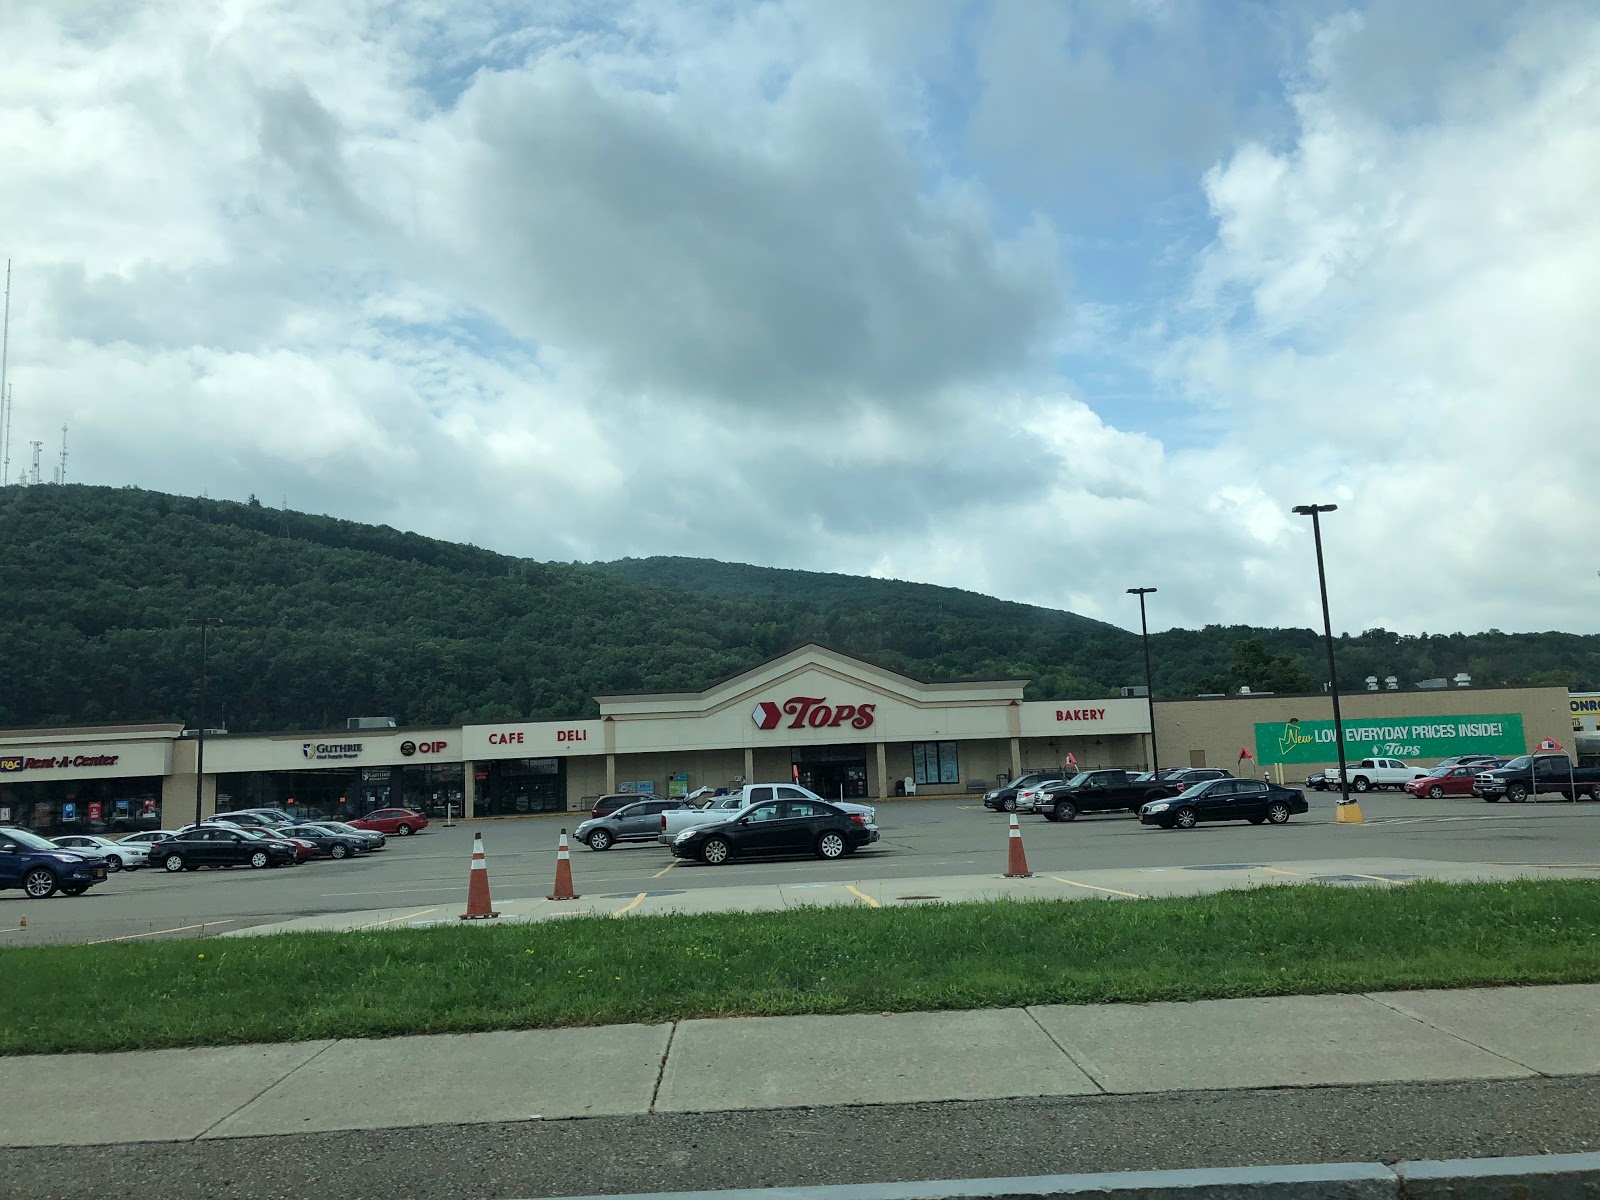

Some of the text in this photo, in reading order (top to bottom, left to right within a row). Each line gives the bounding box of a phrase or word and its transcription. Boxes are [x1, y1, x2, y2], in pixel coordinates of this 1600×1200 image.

[1569, 700, 1600, 712] ONR
[1056, 709, 1105, 721] BAKERY
[488, 732, 524, 745] CAFE
[557, 730, 587, 742] DELI
[1285, 729, 1313, 745] New
[1345, 726, 1408, 742] EVERYDAY
[1412, 724, 1456, 739] PRICES
[1458, 722, 1503, 737] INSIDE!
[316, 743, 363, 753] GUTHRIE
[419, 741, 448, 753] OIP
[1, 760, 20, 770] RAC
